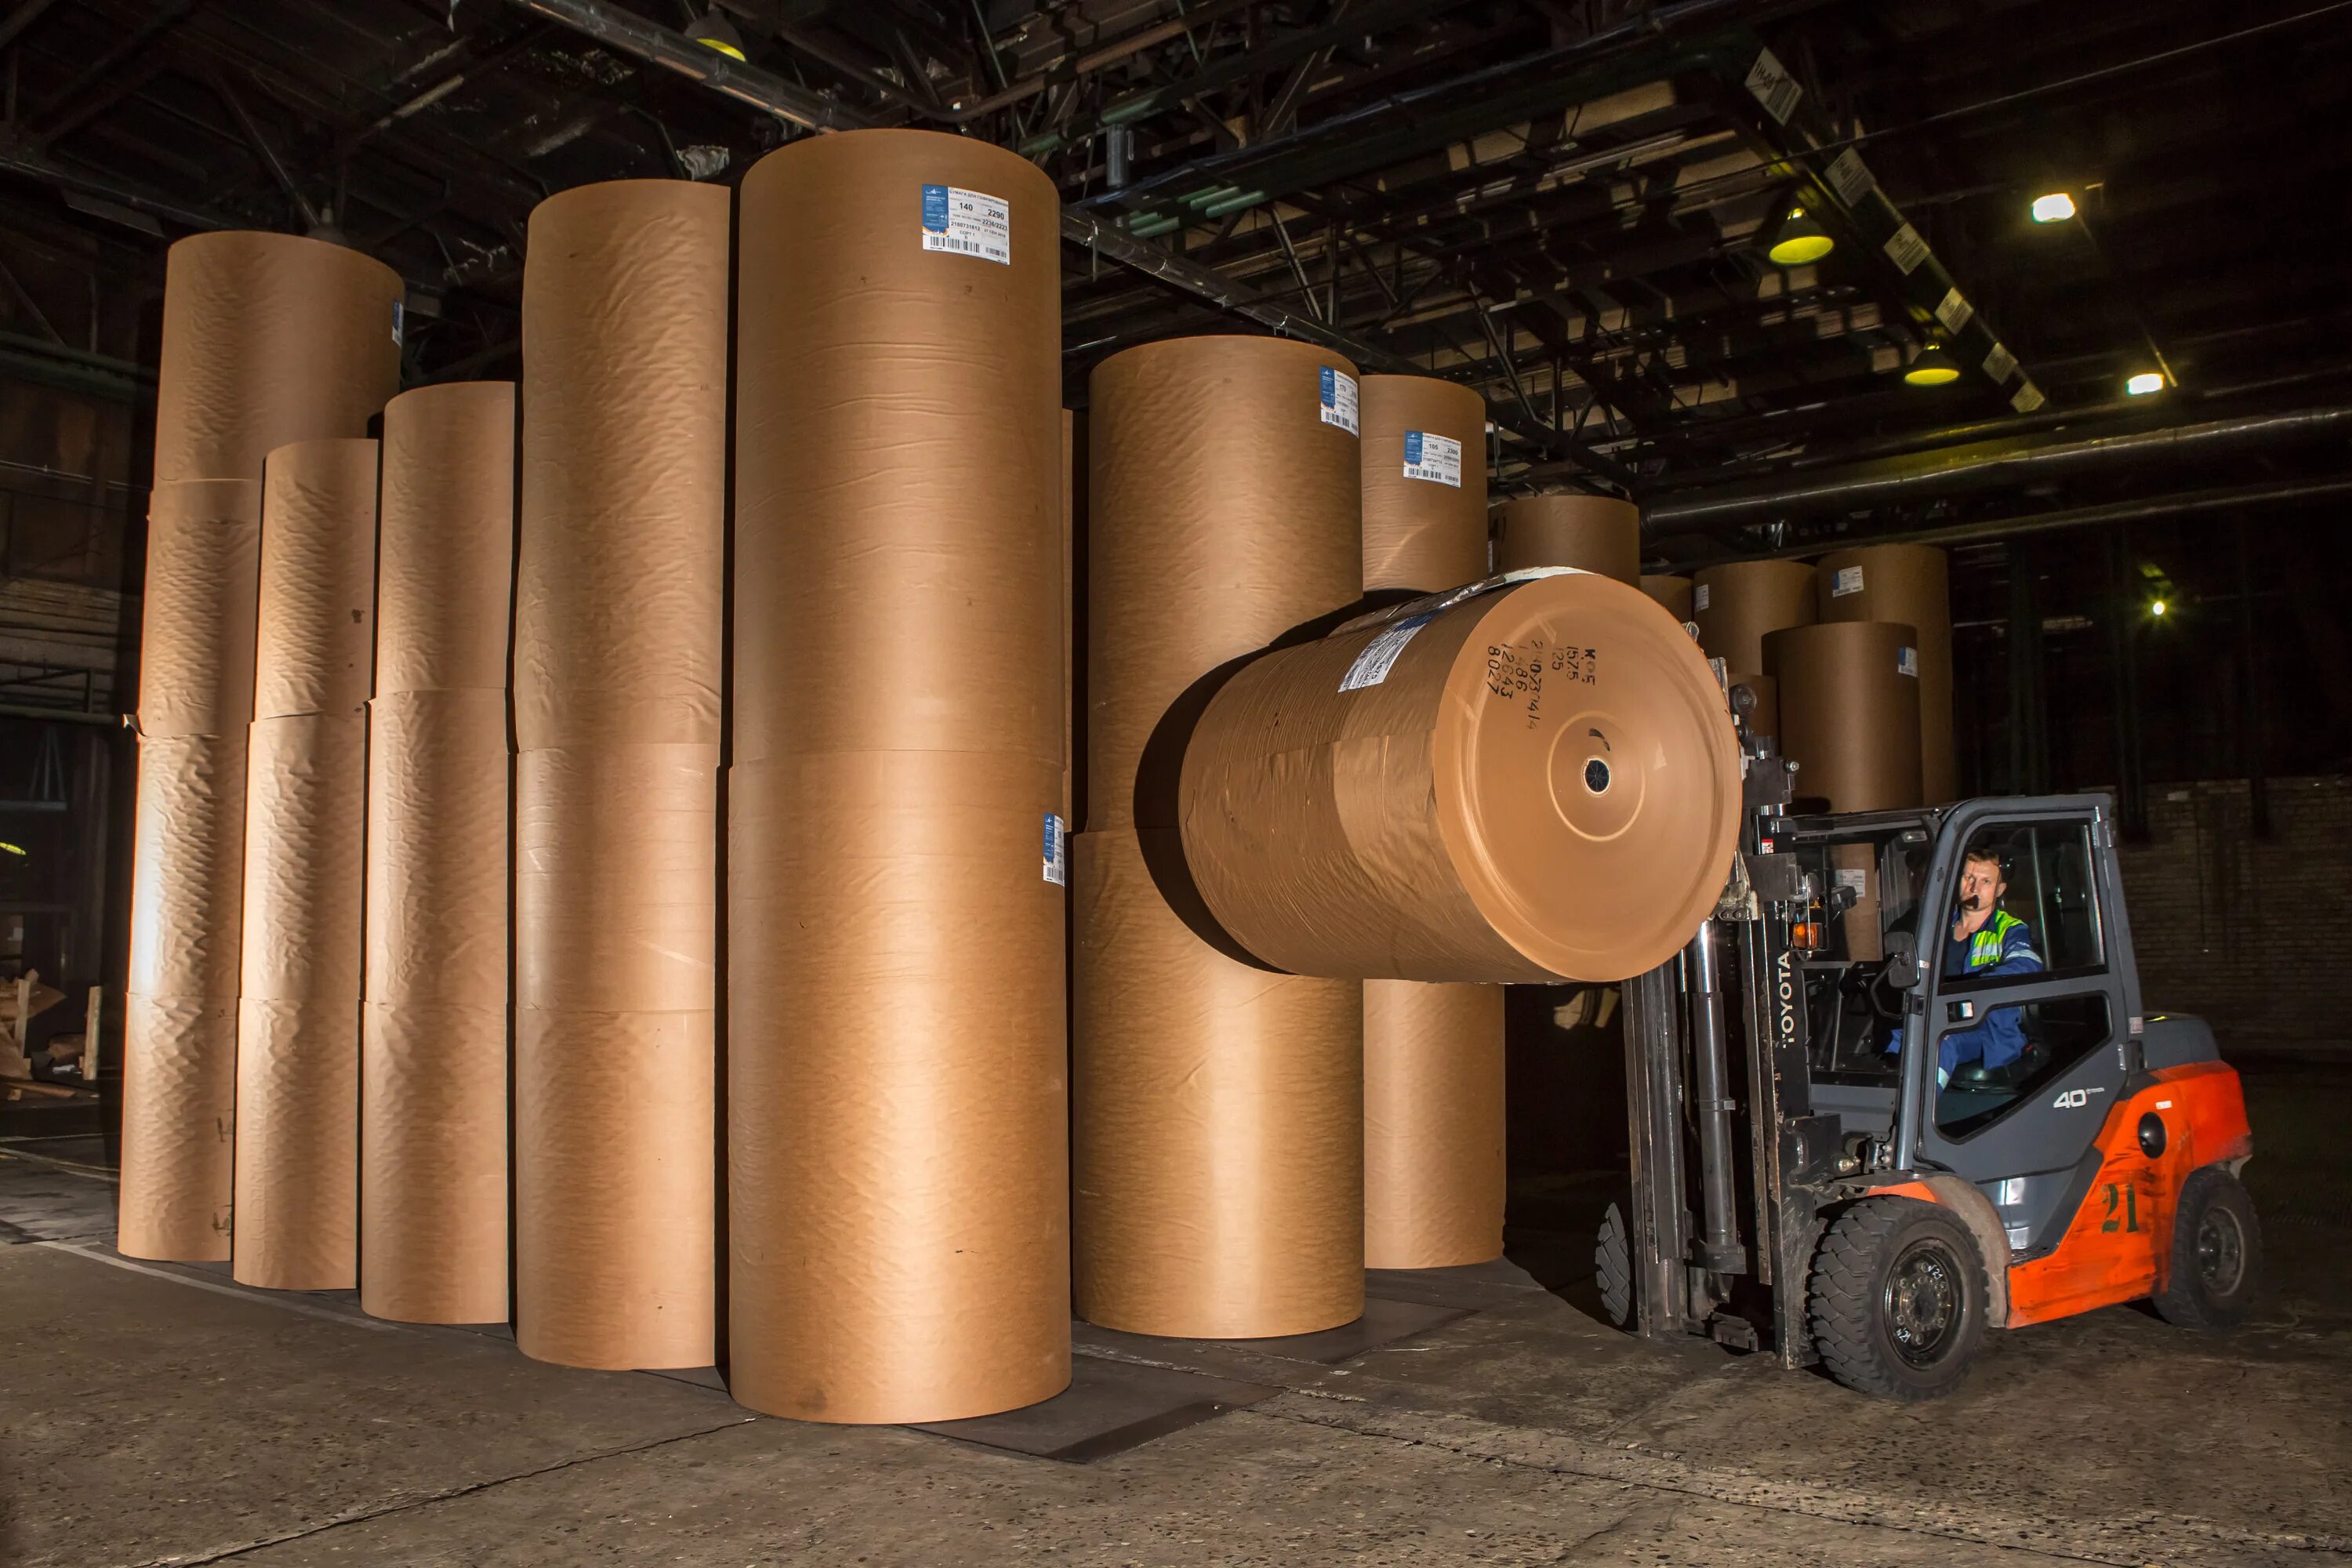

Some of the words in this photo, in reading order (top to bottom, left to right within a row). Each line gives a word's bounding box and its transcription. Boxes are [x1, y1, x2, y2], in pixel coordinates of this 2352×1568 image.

[959, 202, 973, 211] 140
[988, 209, 1004, 220] 2290
[1486, 645, 1501, 695] 8027
[1500, 643, 1515, 699] 12643
[1552, 647, 1565, 671] 125
[1777, 951, 1795, 1048] TOYOTA
[2053, 1089, 2087, 1109] 40
[2101, 1183, 2140, 1235] 21
